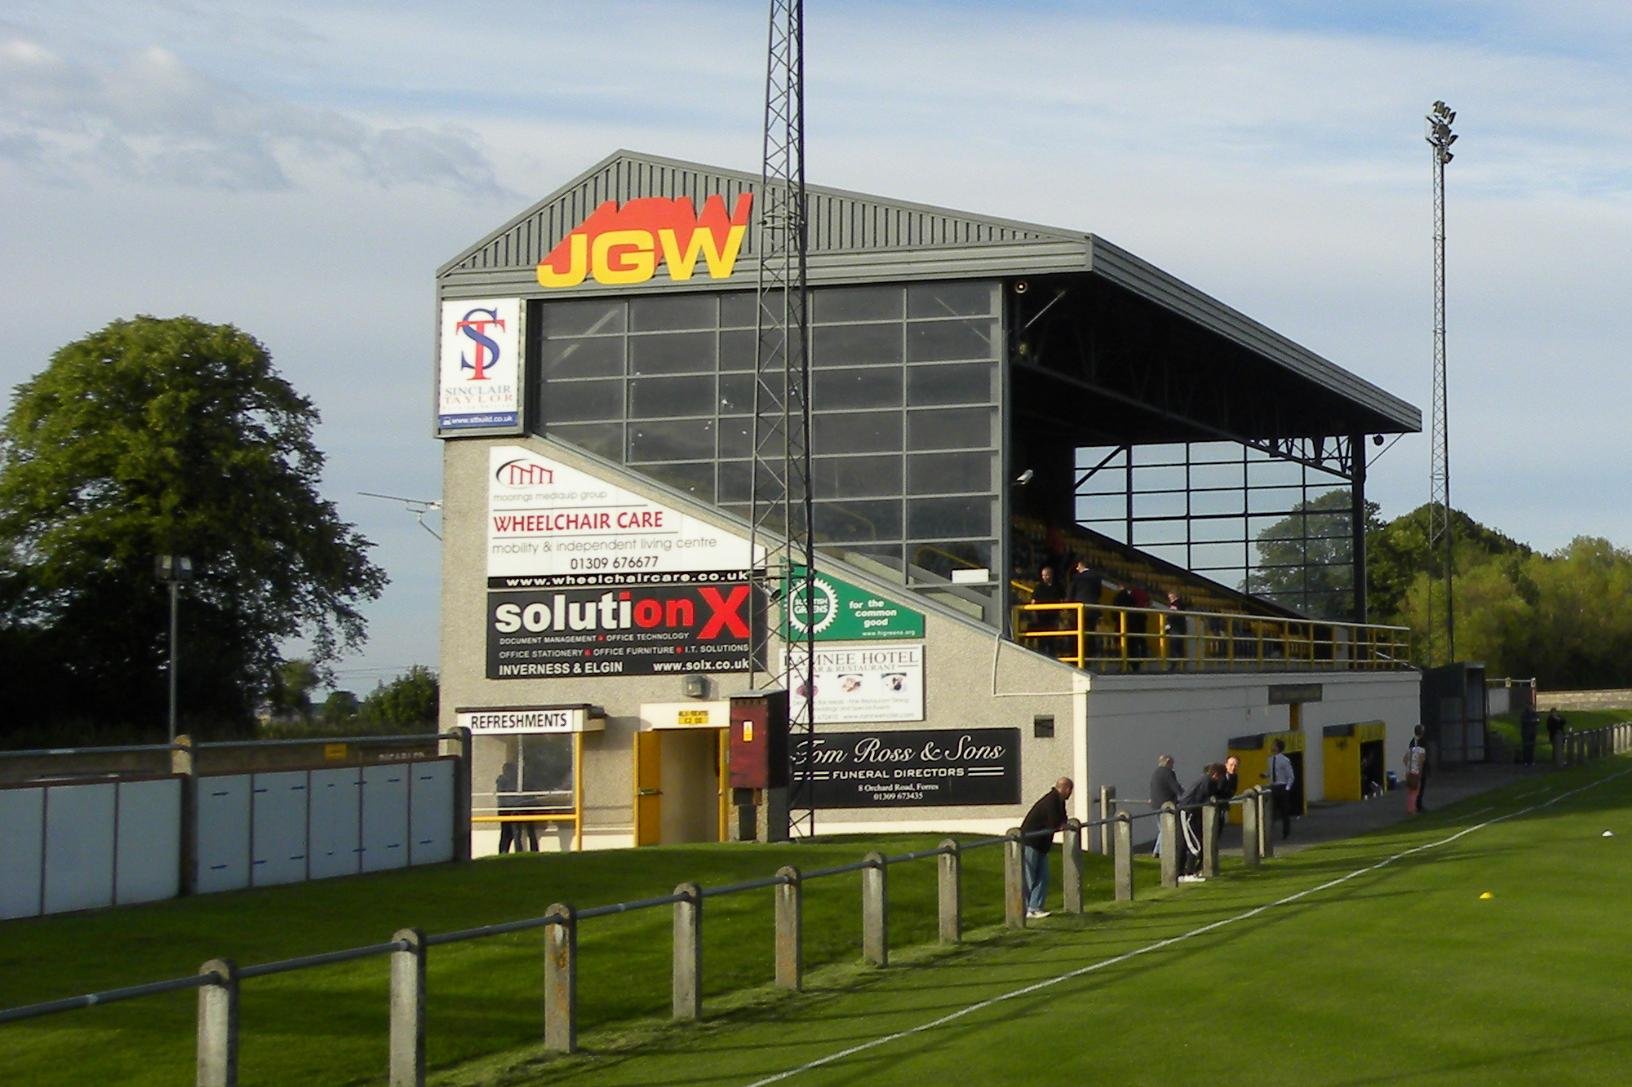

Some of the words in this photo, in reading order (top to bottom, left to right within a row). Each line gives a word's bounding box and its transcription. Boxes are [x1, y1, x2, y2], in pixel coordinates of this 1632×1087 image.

[536, 224, 748, 289] JGW
[445, 385, 511, 396] SINCLAIR
[493, 513, 611, 532] WHEELCHAIR
[617, 511, 663, 528] CARE
[492, 543, 539, 554] mobility
[543, 542, 552, 552] &
[556, 539, 637, 552] independent
[641, 536, 672, 551] living
[677, 537, 717, 549] centre
[570, 558, 608, 570] 01309
[613, 556, 659, 569] 676677
[506, 570, 749, 587] www.wheelchaircare.co.uk
[848, 600, 864, 609] for
[867, 599, 885, 608] the
[854, 609, 898, 617] common
[863, 618, 889, 628] good
[499, 637, 542, 645] DOCUMENT
[544, 635, 597, 643] MANAGEMENT
[606, 634, 634, 642] OFFICE
[637, 632, 690, 640] TECHNOLOGY
[499, 651, 530, 659] OFFICE
[532, 649, 584, 658] STATIONERY
[593, 648, 624, 656] OFFICE
[626, 646, 675, 655] FURNITURE
[700, 644, 749, 653] SOLUTIONS
[862, 651, 920, 665] HOTEL
[499, 663, 571, 676] INVERNESS
[573, 663, 582, 673] &
[584, 661, 623, 673] ELGIN
[470, 713, 567, 729] REFRESHMENTS
[853, 738, 916, 763] Ross
[920, 742, 942, 761] &
[944, 735, 1006, 761] Sons
[832, 770, 890, 780] FUNERAL
[893, 767, 965, 778] DIRECTORS
[864, 784, 893, 792] Orchard
